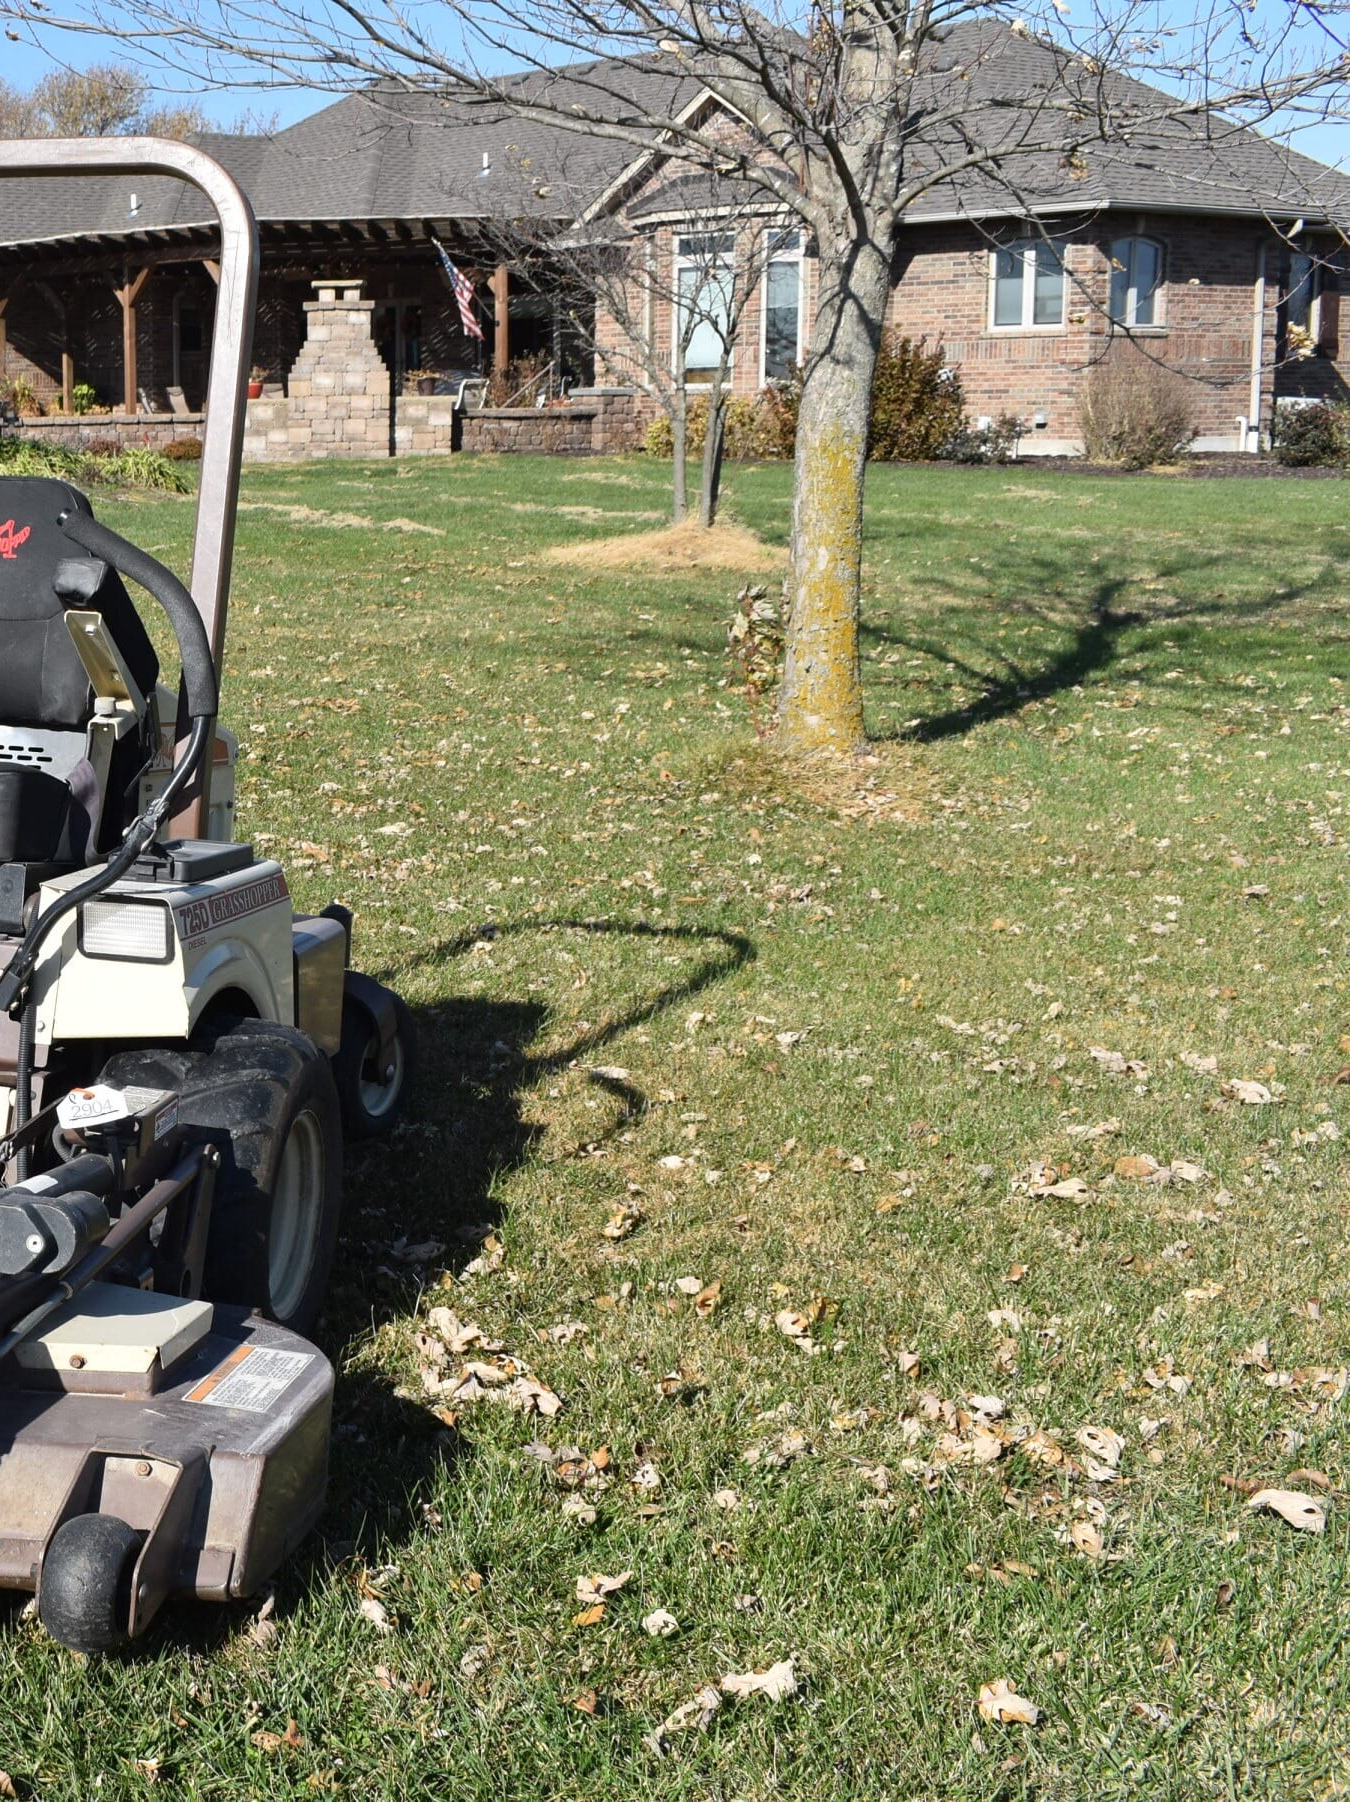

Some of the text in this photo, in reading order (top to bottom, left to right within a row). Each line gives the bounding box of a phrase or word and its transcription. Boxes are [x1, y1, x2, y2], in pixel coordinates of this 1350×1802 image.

[179, 879, 281, 936] 725D GRASSHOPPER
[70, 1099, 114, 1119] 2904
